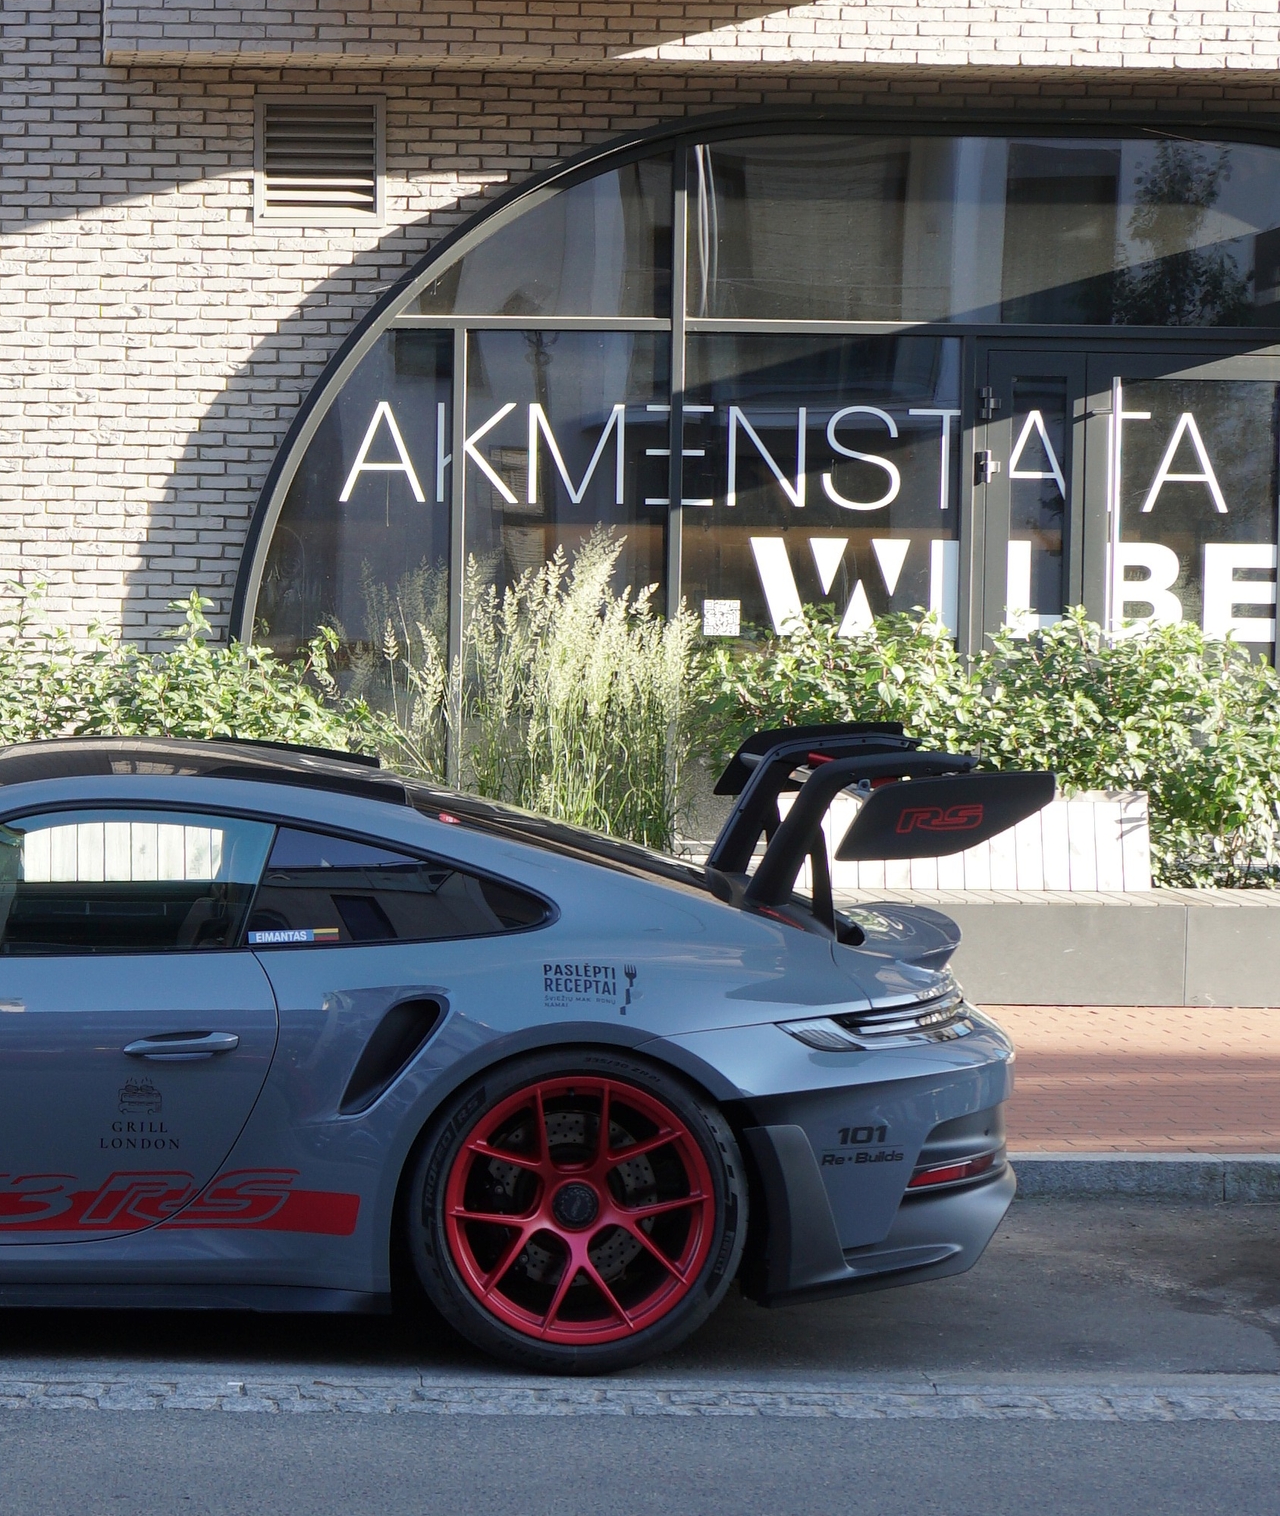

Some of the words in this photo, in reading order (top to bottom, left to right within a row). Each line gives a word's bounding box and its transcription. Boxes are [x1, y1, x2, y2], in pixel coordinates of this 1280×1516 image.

[895, 804, 983, 833] RS
[255, 931, 307, 943] EIMANTAS
[543, 978, 617, 996] RECEPTAI
[112, 1121, 168, 1134] GRILL
[837, 1125, 888, 1145] 101
[100, 1137, 181, 1150] LONDON
[79, 1168, 300, 1225] RS
